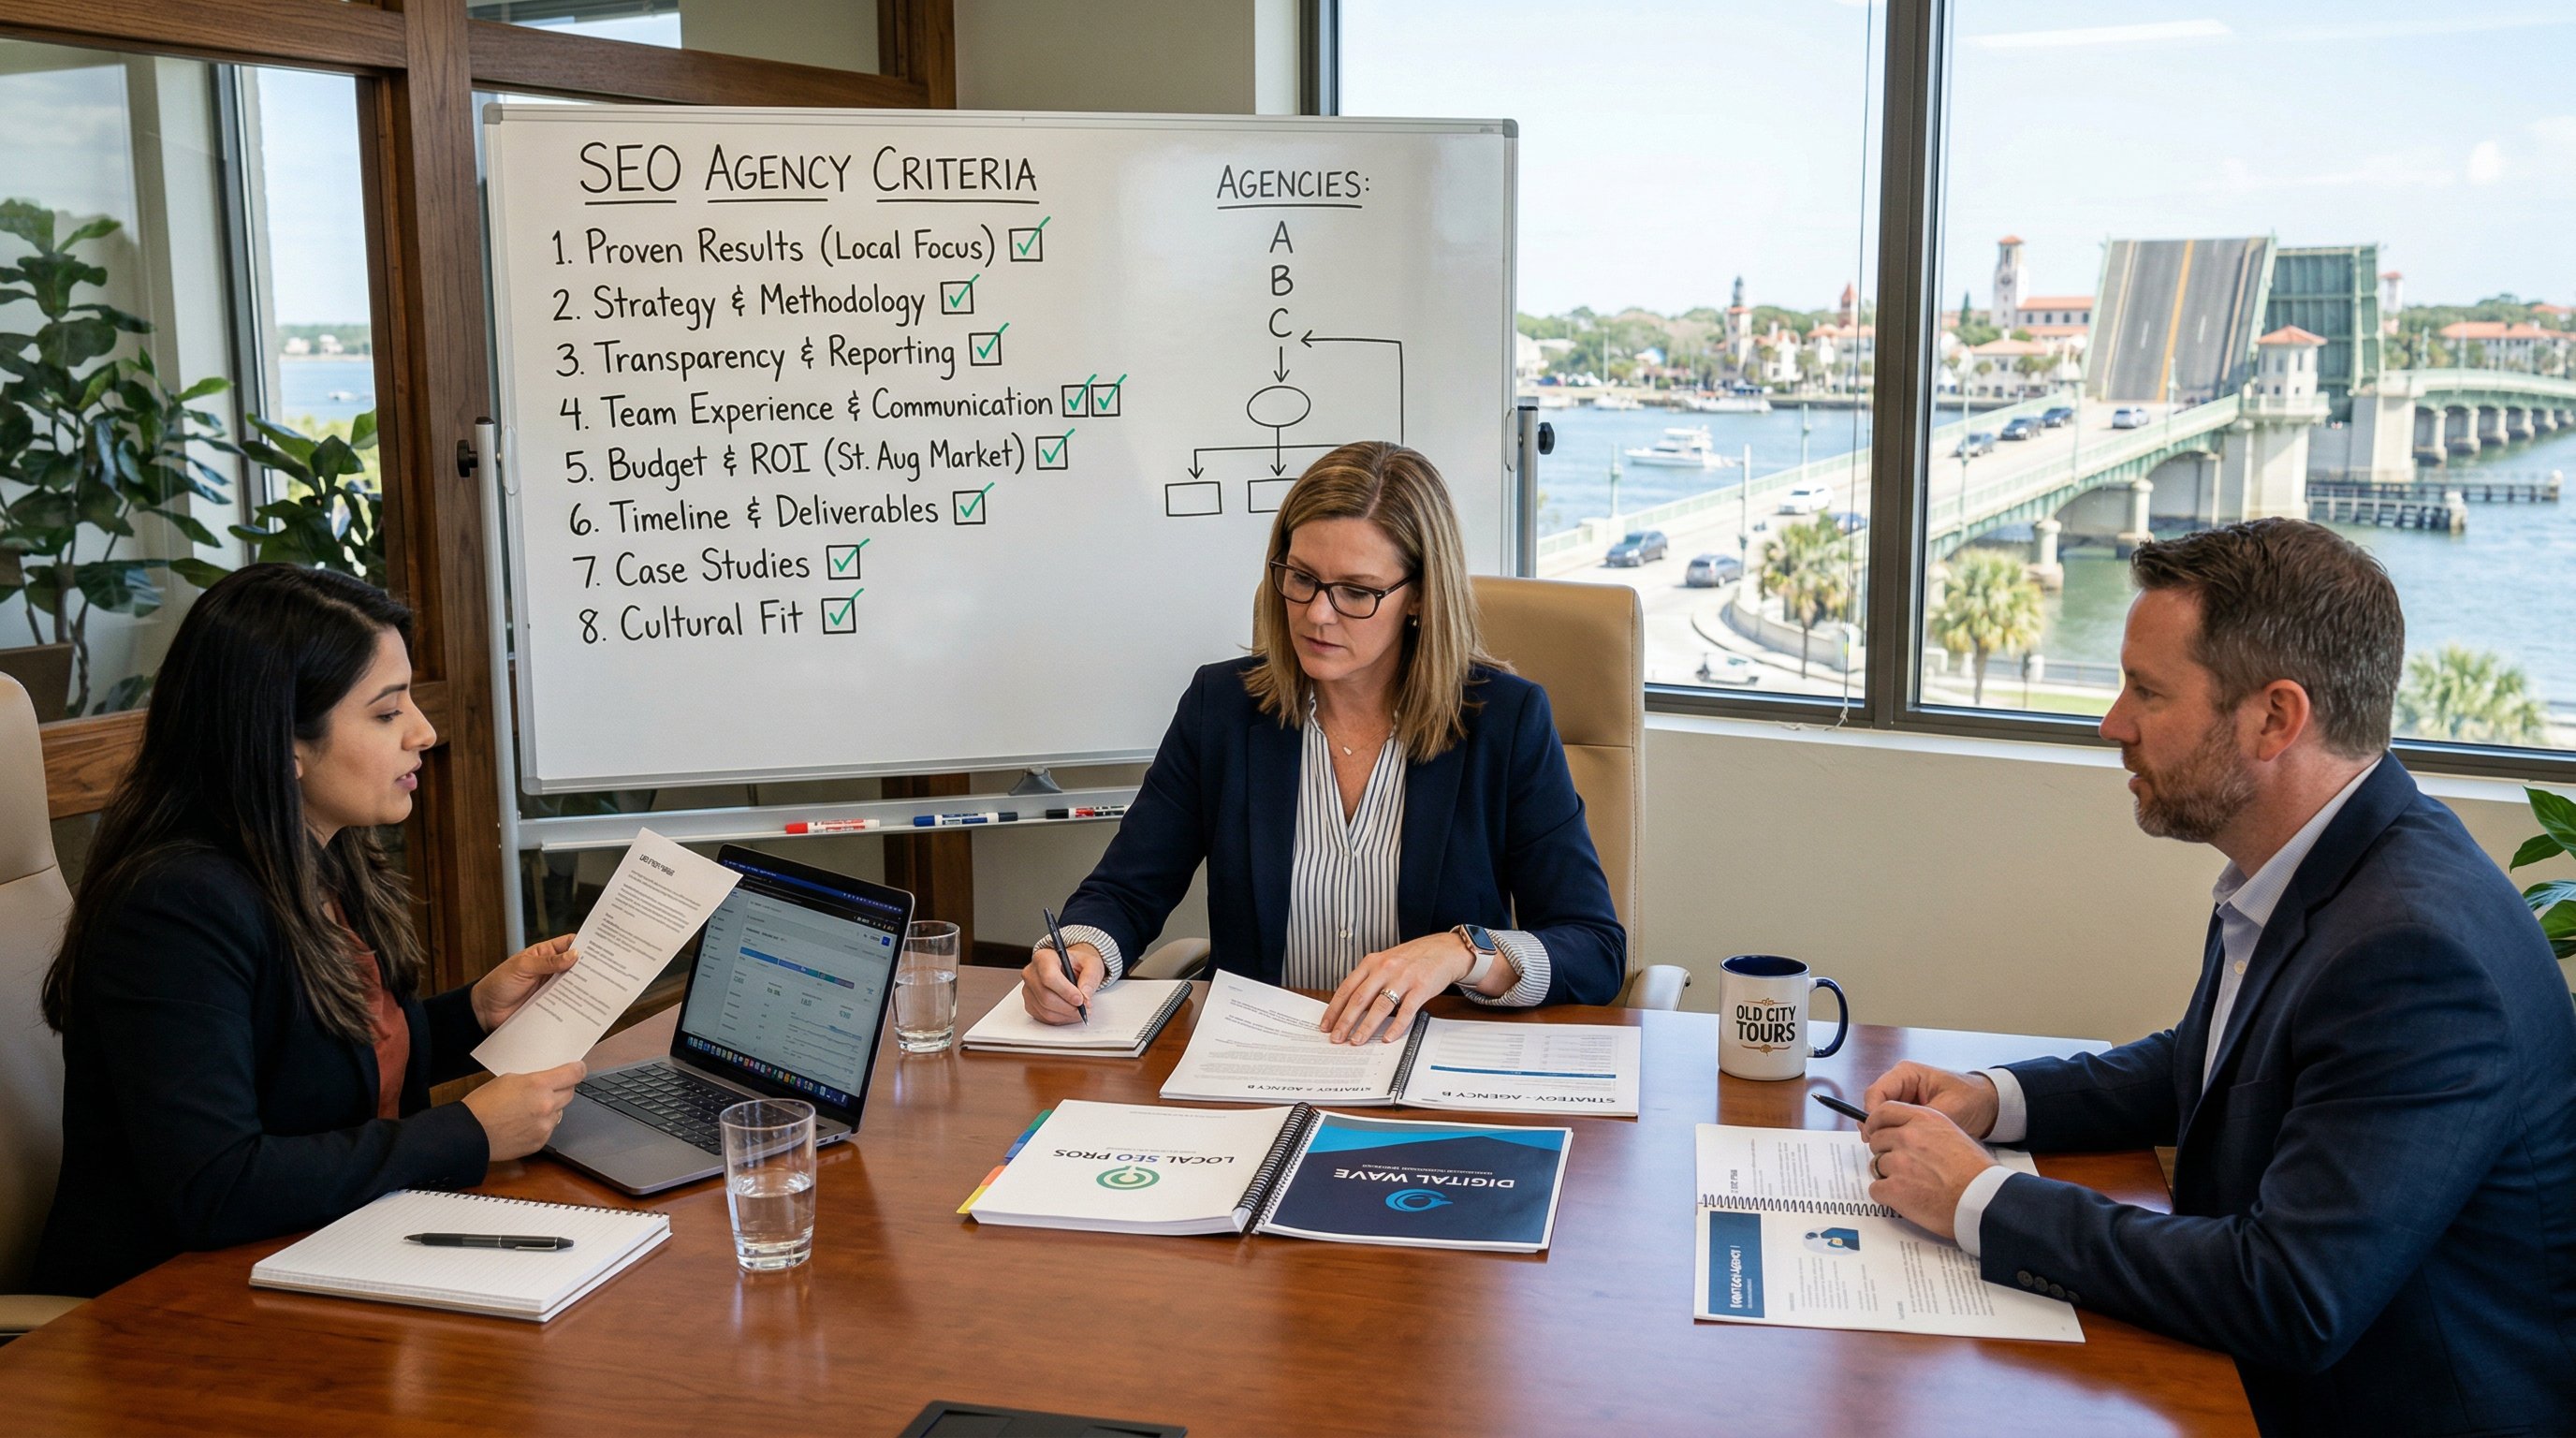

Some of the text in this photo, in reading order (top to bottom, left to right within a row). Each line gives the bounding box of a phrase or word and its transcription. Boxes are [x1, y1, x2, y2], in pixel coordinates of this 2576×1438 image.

[580, 142, 1036, 193] SEO AGENCY CRITERIA
[1217, 165, 1369, 198] AGENCIES:
[552, 224, 994, 268] 1. Proven Results (Local Focus)
[1270, 221, 1293, 253] A
[1272, 265, 1293, 296] B
[553, 284, 925, 330] 2. Strategy & Methodology
[1269, 308, 1292, 337] C
[556, 334, 955, 382] 3. Transparency & Reporting
[560, 387, 1052, 434] 4. Team Experience & Communication
[566, 433, 1024, 492] 5. Budget & ROI (St. Aug Market)
[570, 494, 938, 536] 6. Timeline & Deliverables
[573, 548, 810, 588] 7. Case Studies
[579, 599, 803, 644] 8. Cultural Fit
[1736, 1005, 1795, 1021] OLD CITY
[1736, 1020, 1795, 1043] TOURS
[1053, 1149, 1113, 1160] PROS
[1116, 1154, 1161, 1163] SEO
[1166, 1155, 1235, 1165] LOCAL
[1333, 1168, 1409, 1183] WAVE
[1417, 1174, 1515, 1188] DIGITAL
